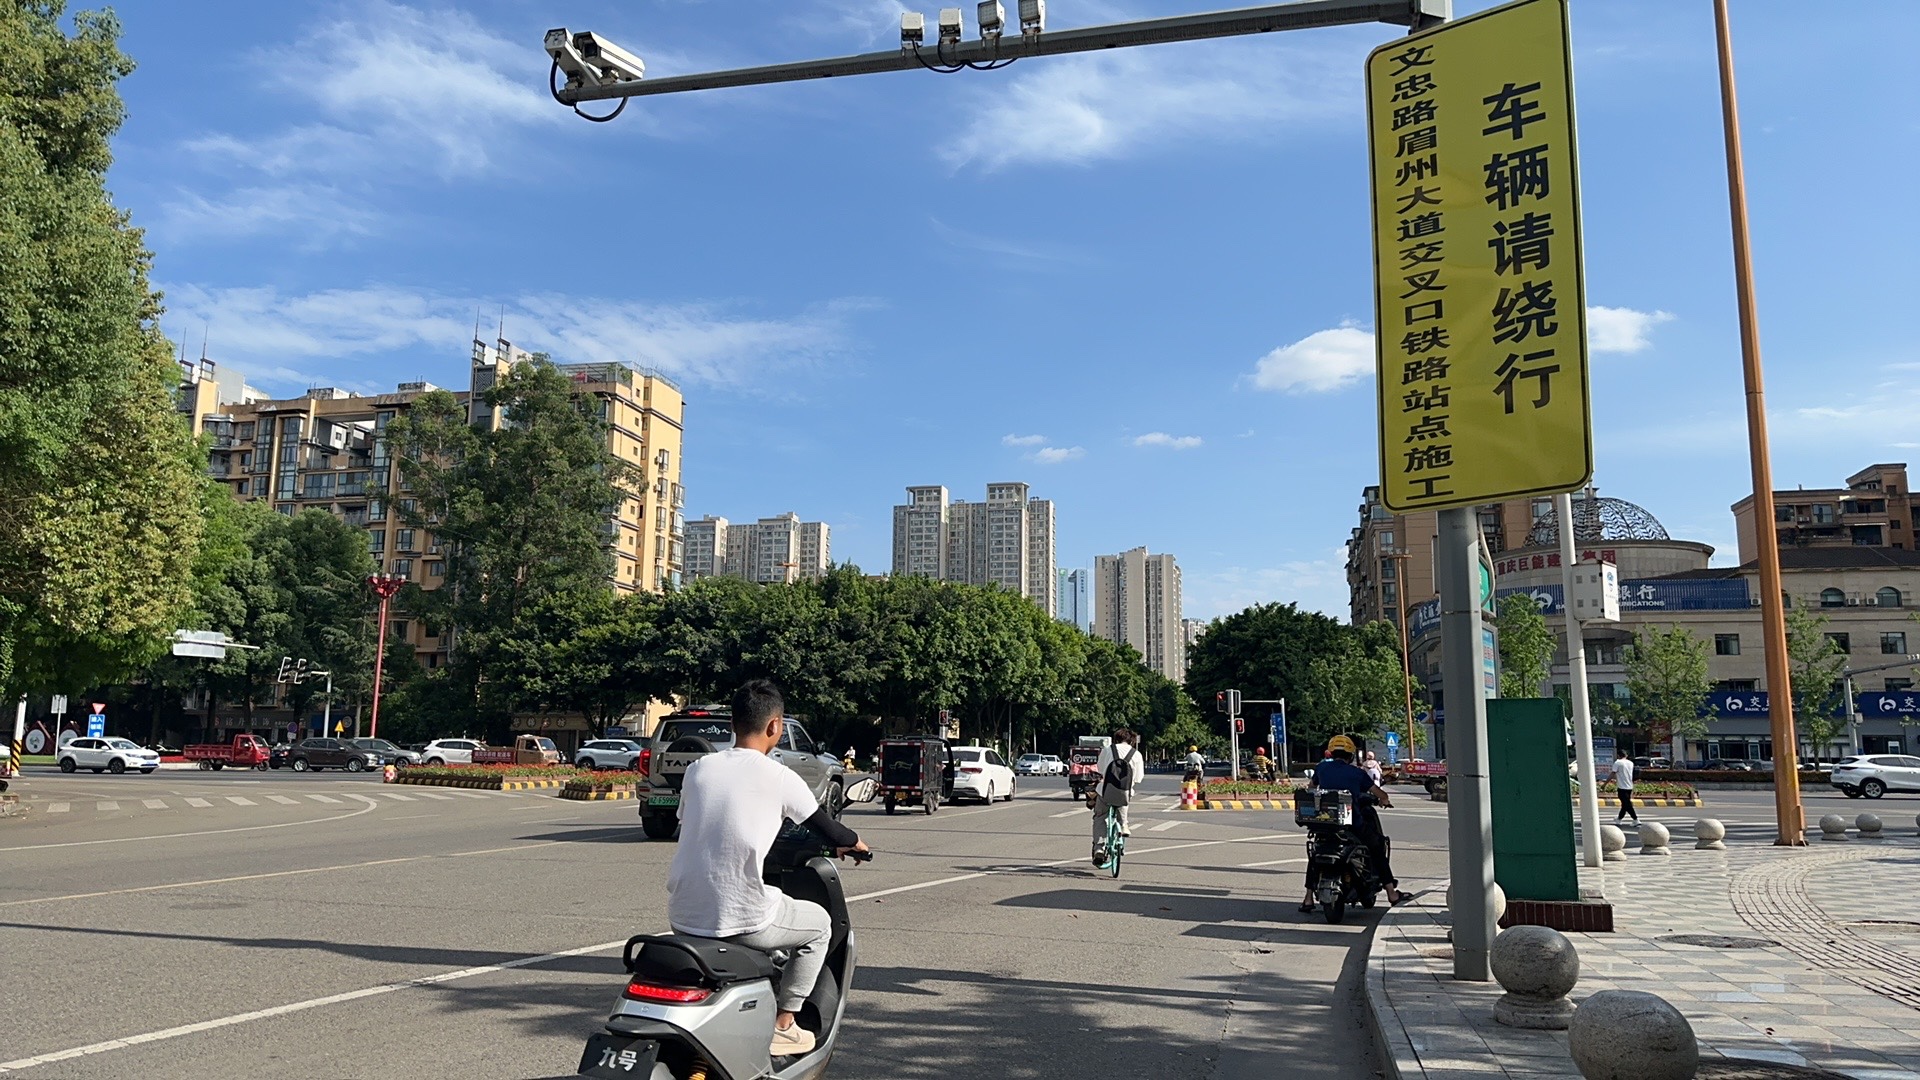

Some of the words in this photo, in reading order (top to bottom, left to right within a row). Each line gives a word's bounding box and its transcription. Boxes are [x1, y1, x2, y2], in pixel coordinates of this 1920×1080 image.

[1389, 44, 1454, 501] 文忠路眉州大道交叉口铁路站点施工
[1483, 81, 1560, 415] 车辆请绕行
[1498, 550, 1616, 576] 重庆巨能建集团
[598, 1047, 637, 1072] 九号
